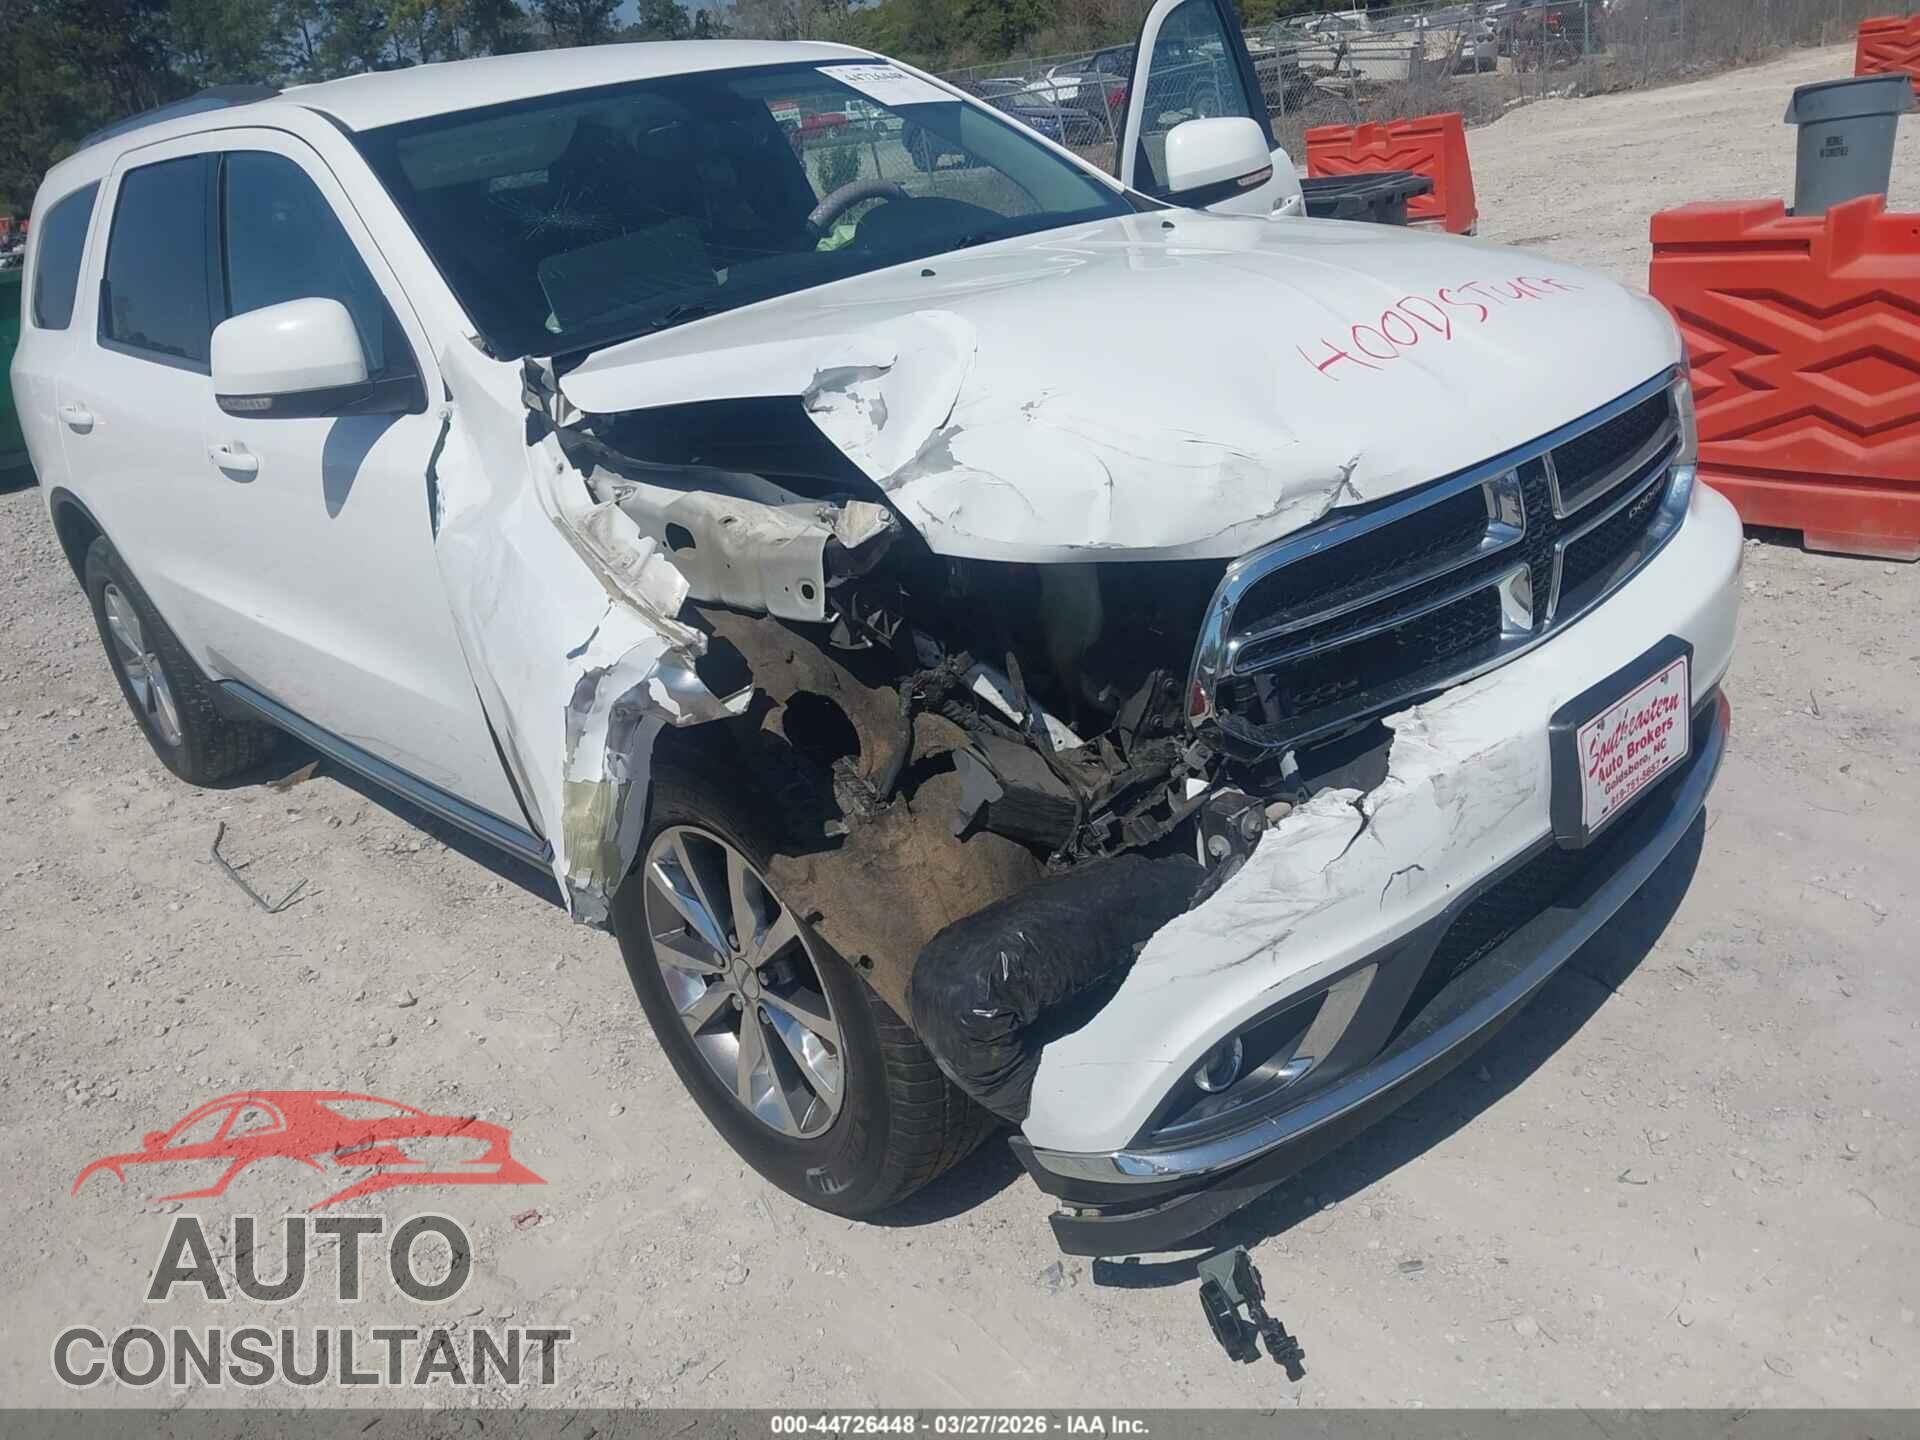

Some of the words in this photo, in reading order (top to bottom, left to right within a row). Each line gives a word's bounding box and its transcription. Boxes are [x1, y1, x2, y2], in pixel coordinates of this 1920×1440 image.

[1296, 296, 1451, 381] HOOD
[1589, 693, 1679, 778] Southeastern
[1599, 754, 1623, 784] Auto
[1627, 717, 1673, 760] Brokers
[1605, 754, 1651, 795] Goldsboro,
[1654, 738, 1667, 755] NC
